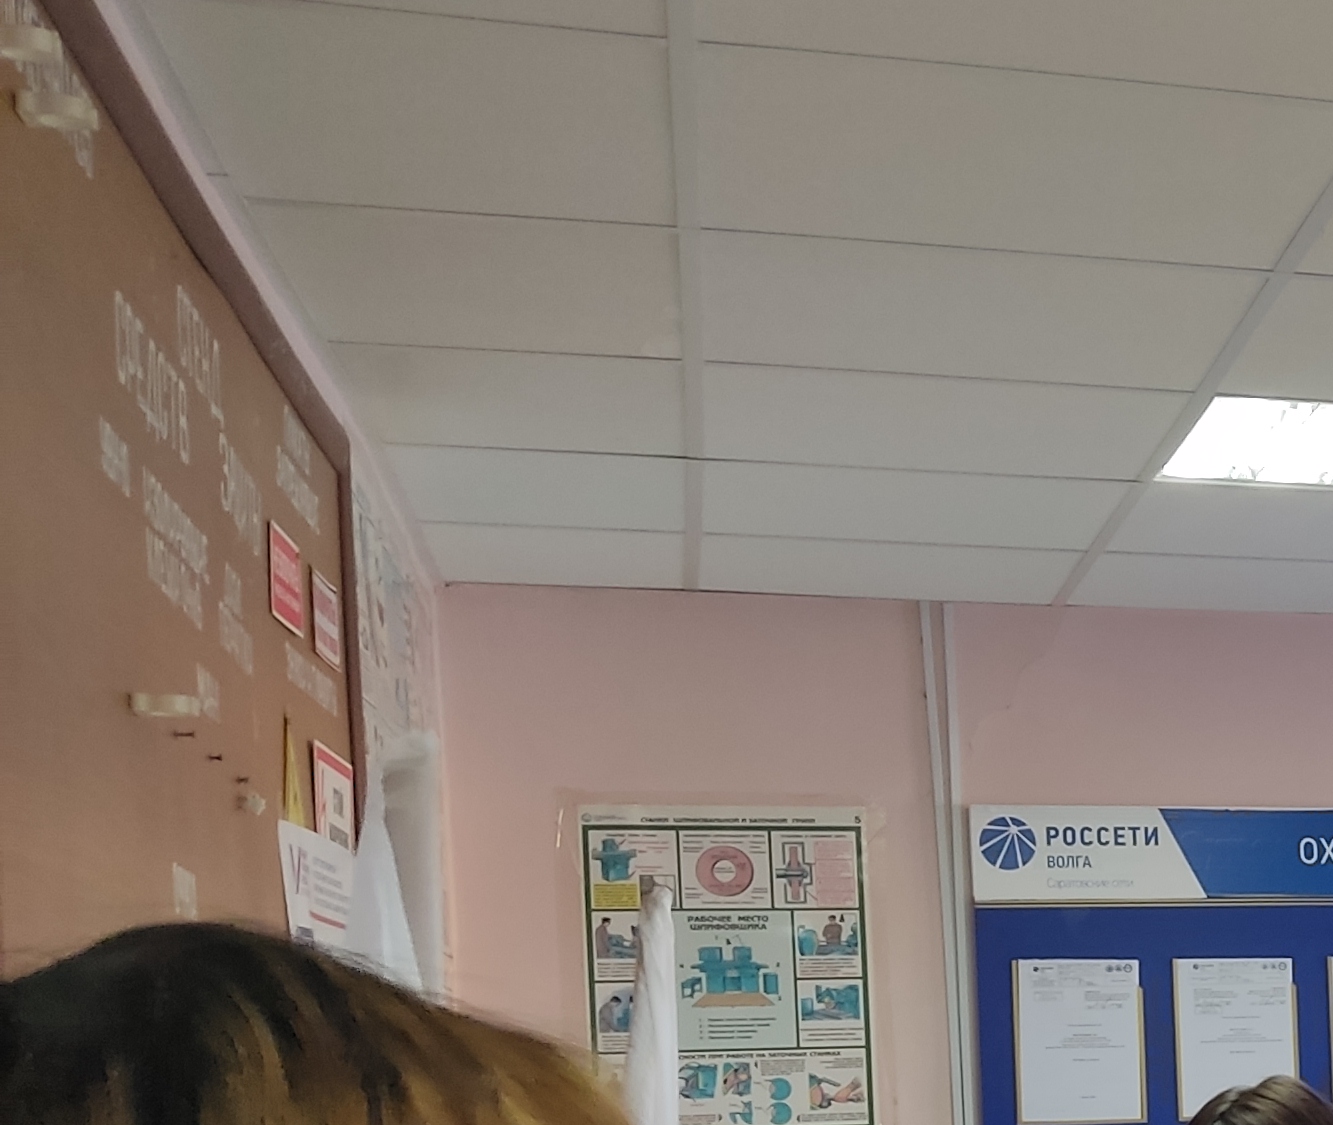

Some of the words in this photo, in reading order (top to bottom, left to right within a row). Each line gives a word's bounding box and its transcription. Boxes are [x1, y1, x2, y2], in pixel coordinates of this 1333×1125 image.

[115, 290, 190, 465] СРЕДСТВ
[854, 816, 862, 824] 5
[1045, 826, 1160, 847] РОССЕТИ
[1046, 855, 1092, 868] ВОЛГА
[687, 915, 732, 923] РАБОЧЕЕ
[737, 915, 769, 923] МЕСТО
